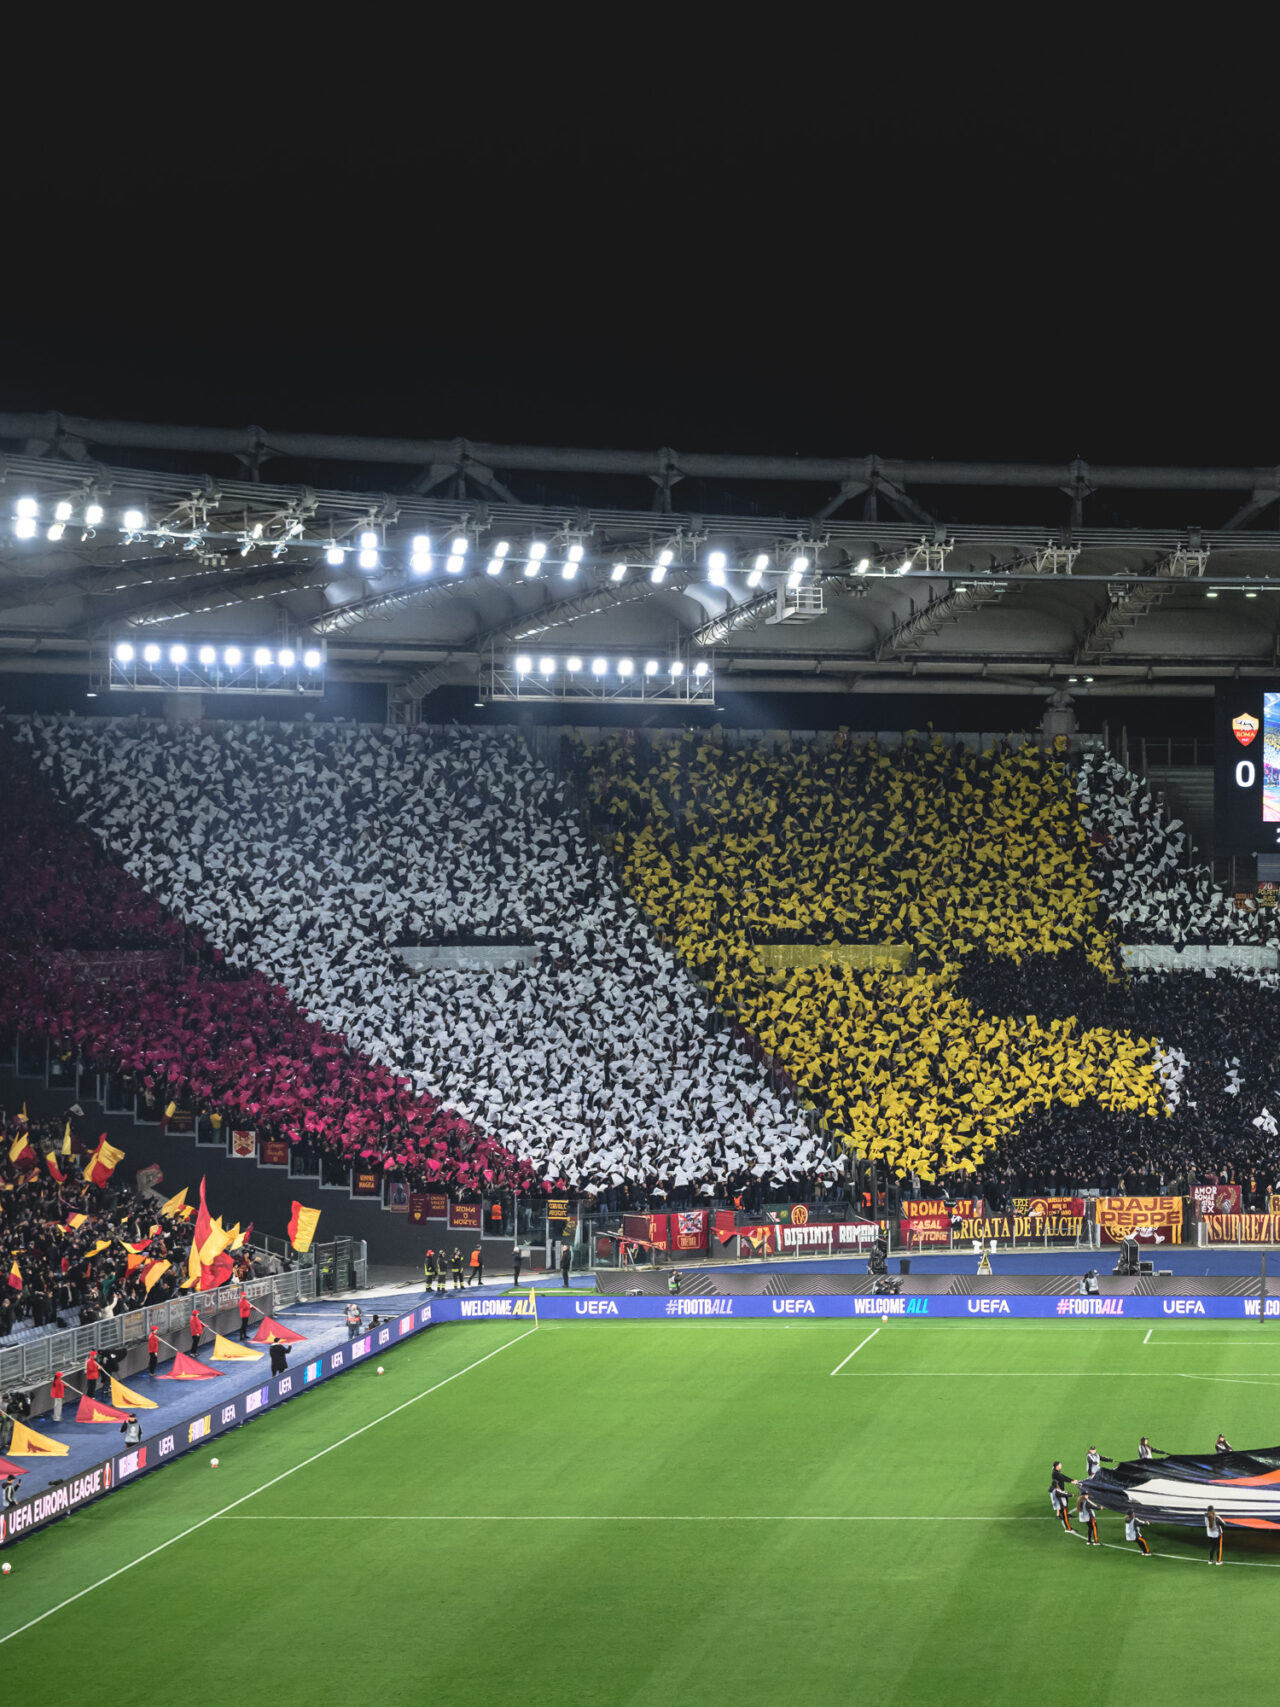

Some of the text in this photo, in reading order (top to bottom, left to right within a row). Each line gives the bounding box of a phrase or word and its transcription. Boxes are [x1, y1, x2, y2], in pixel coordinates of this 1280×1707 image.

[1236, 760, 1255, 787] 0
[1194, 1186, 1217, 1194] AMOR
[910, 1201, 948, 1217] ROMA
[1107, 1197, 1174, 1211] DAJE
[1100, 1211, 1181, 1225] PEPPE
[1014, 1217, 1031, 1237] DE
[1035, 1216, 1083, 1237] FALCHI
[784, 1225, 880, 1246] DISTINTI ROMANI
[461, 1299, 537, 1316] WELCOME ALL
[576, 1301, 618, 1314] UEFA
[666, 1299, 733, 1314] #FOOTBALL
[773, 1300, 815, 1314] UEFA
[855, 1298, 929, 1314] WELCOME ALL
[968, 1299, 1010, 1313] UEFA
[1057, 1299, 1123, 1315] #FOOTBALL
[1163, 1300, 1205, 1314] UEFA
[221, 1404, 236, 1425] UEFA
[159, 1434, 175, 1457] UEFA
[9, 1469, 101, 1534] UEFA EUROPA LEAGUE
